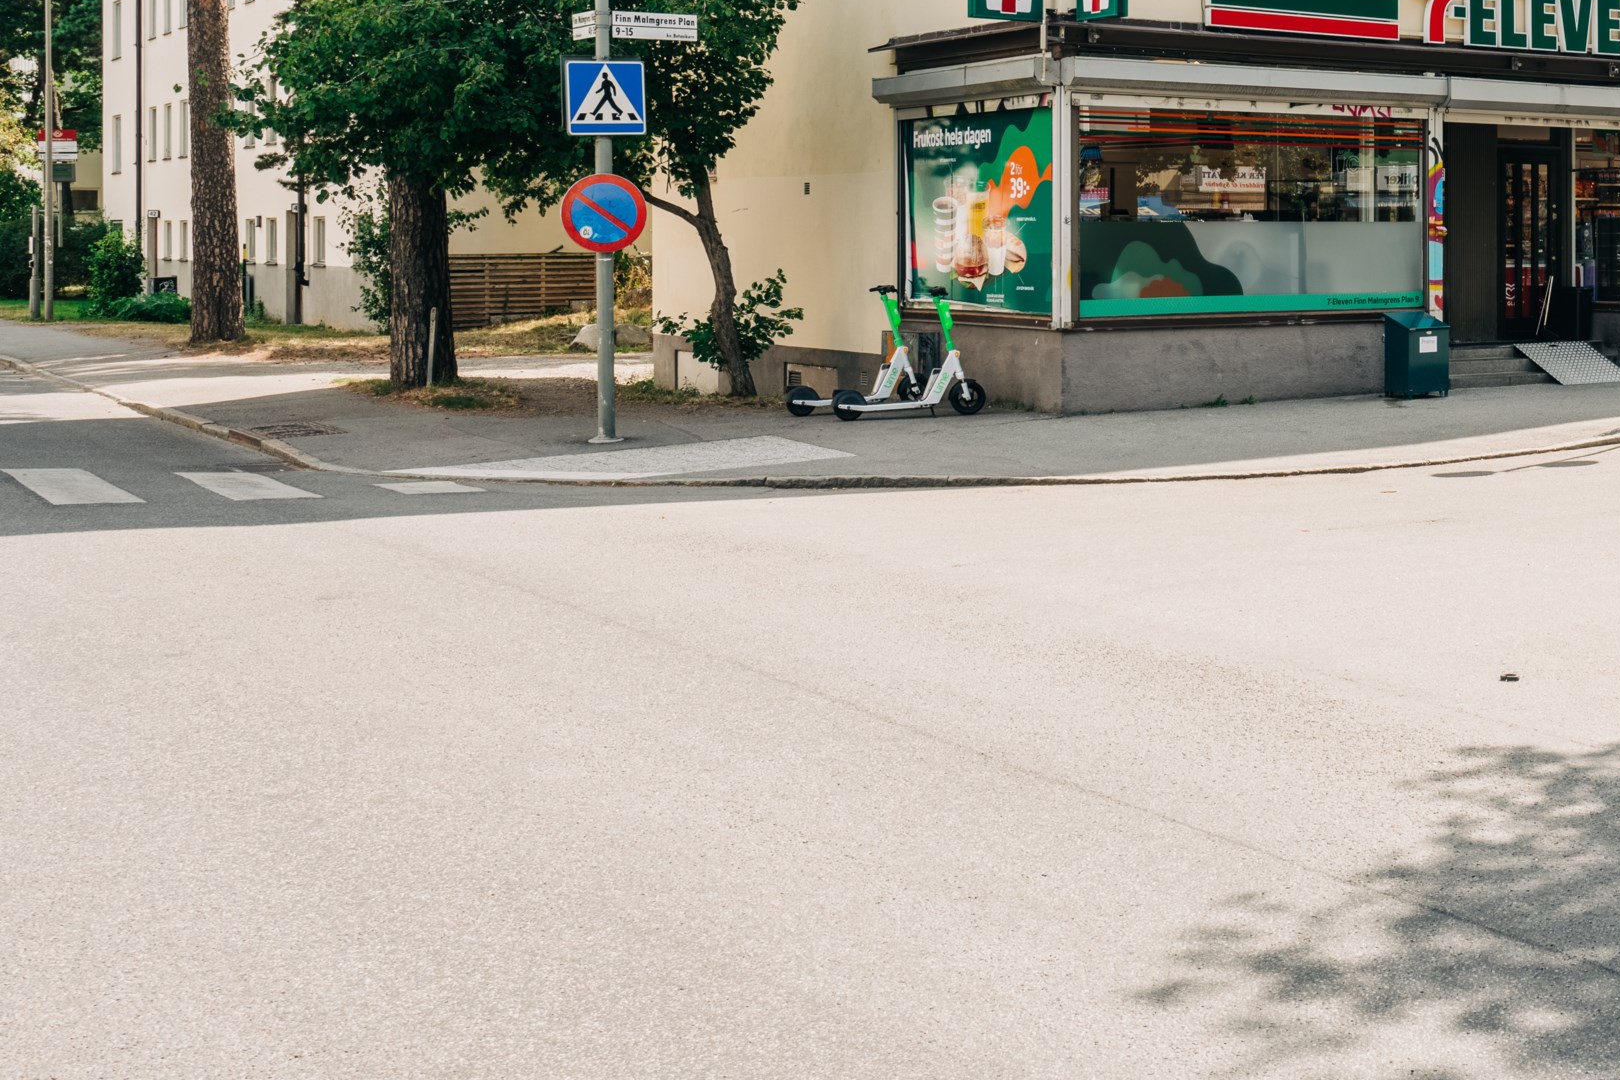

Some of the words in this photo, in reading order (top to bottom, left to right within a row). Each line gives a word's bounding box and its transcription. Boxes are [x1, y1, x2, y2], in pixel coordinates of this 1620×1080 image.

[615, 14, 632, 23] Finn
[634, 16, 676, 26] Malmgrens
[678, 18, 695, 26] Plan
[615, 27, 634, 37] 9-15
[913, 128, 944, 148] Frukost
[944, 126, 962, 146] hela
[964, 126, 992, 150] dagen
[1009, 162, 1016, 176] 2
[1327, 297, 1353, 306] 7-Eleven
[1354, 297, 1367, 305] Finn
[1368, 295, 1400, 306] Malmgrens
[1401, 295, 1414, 304] Plan
[1415, 295, 1420, 303] 9
